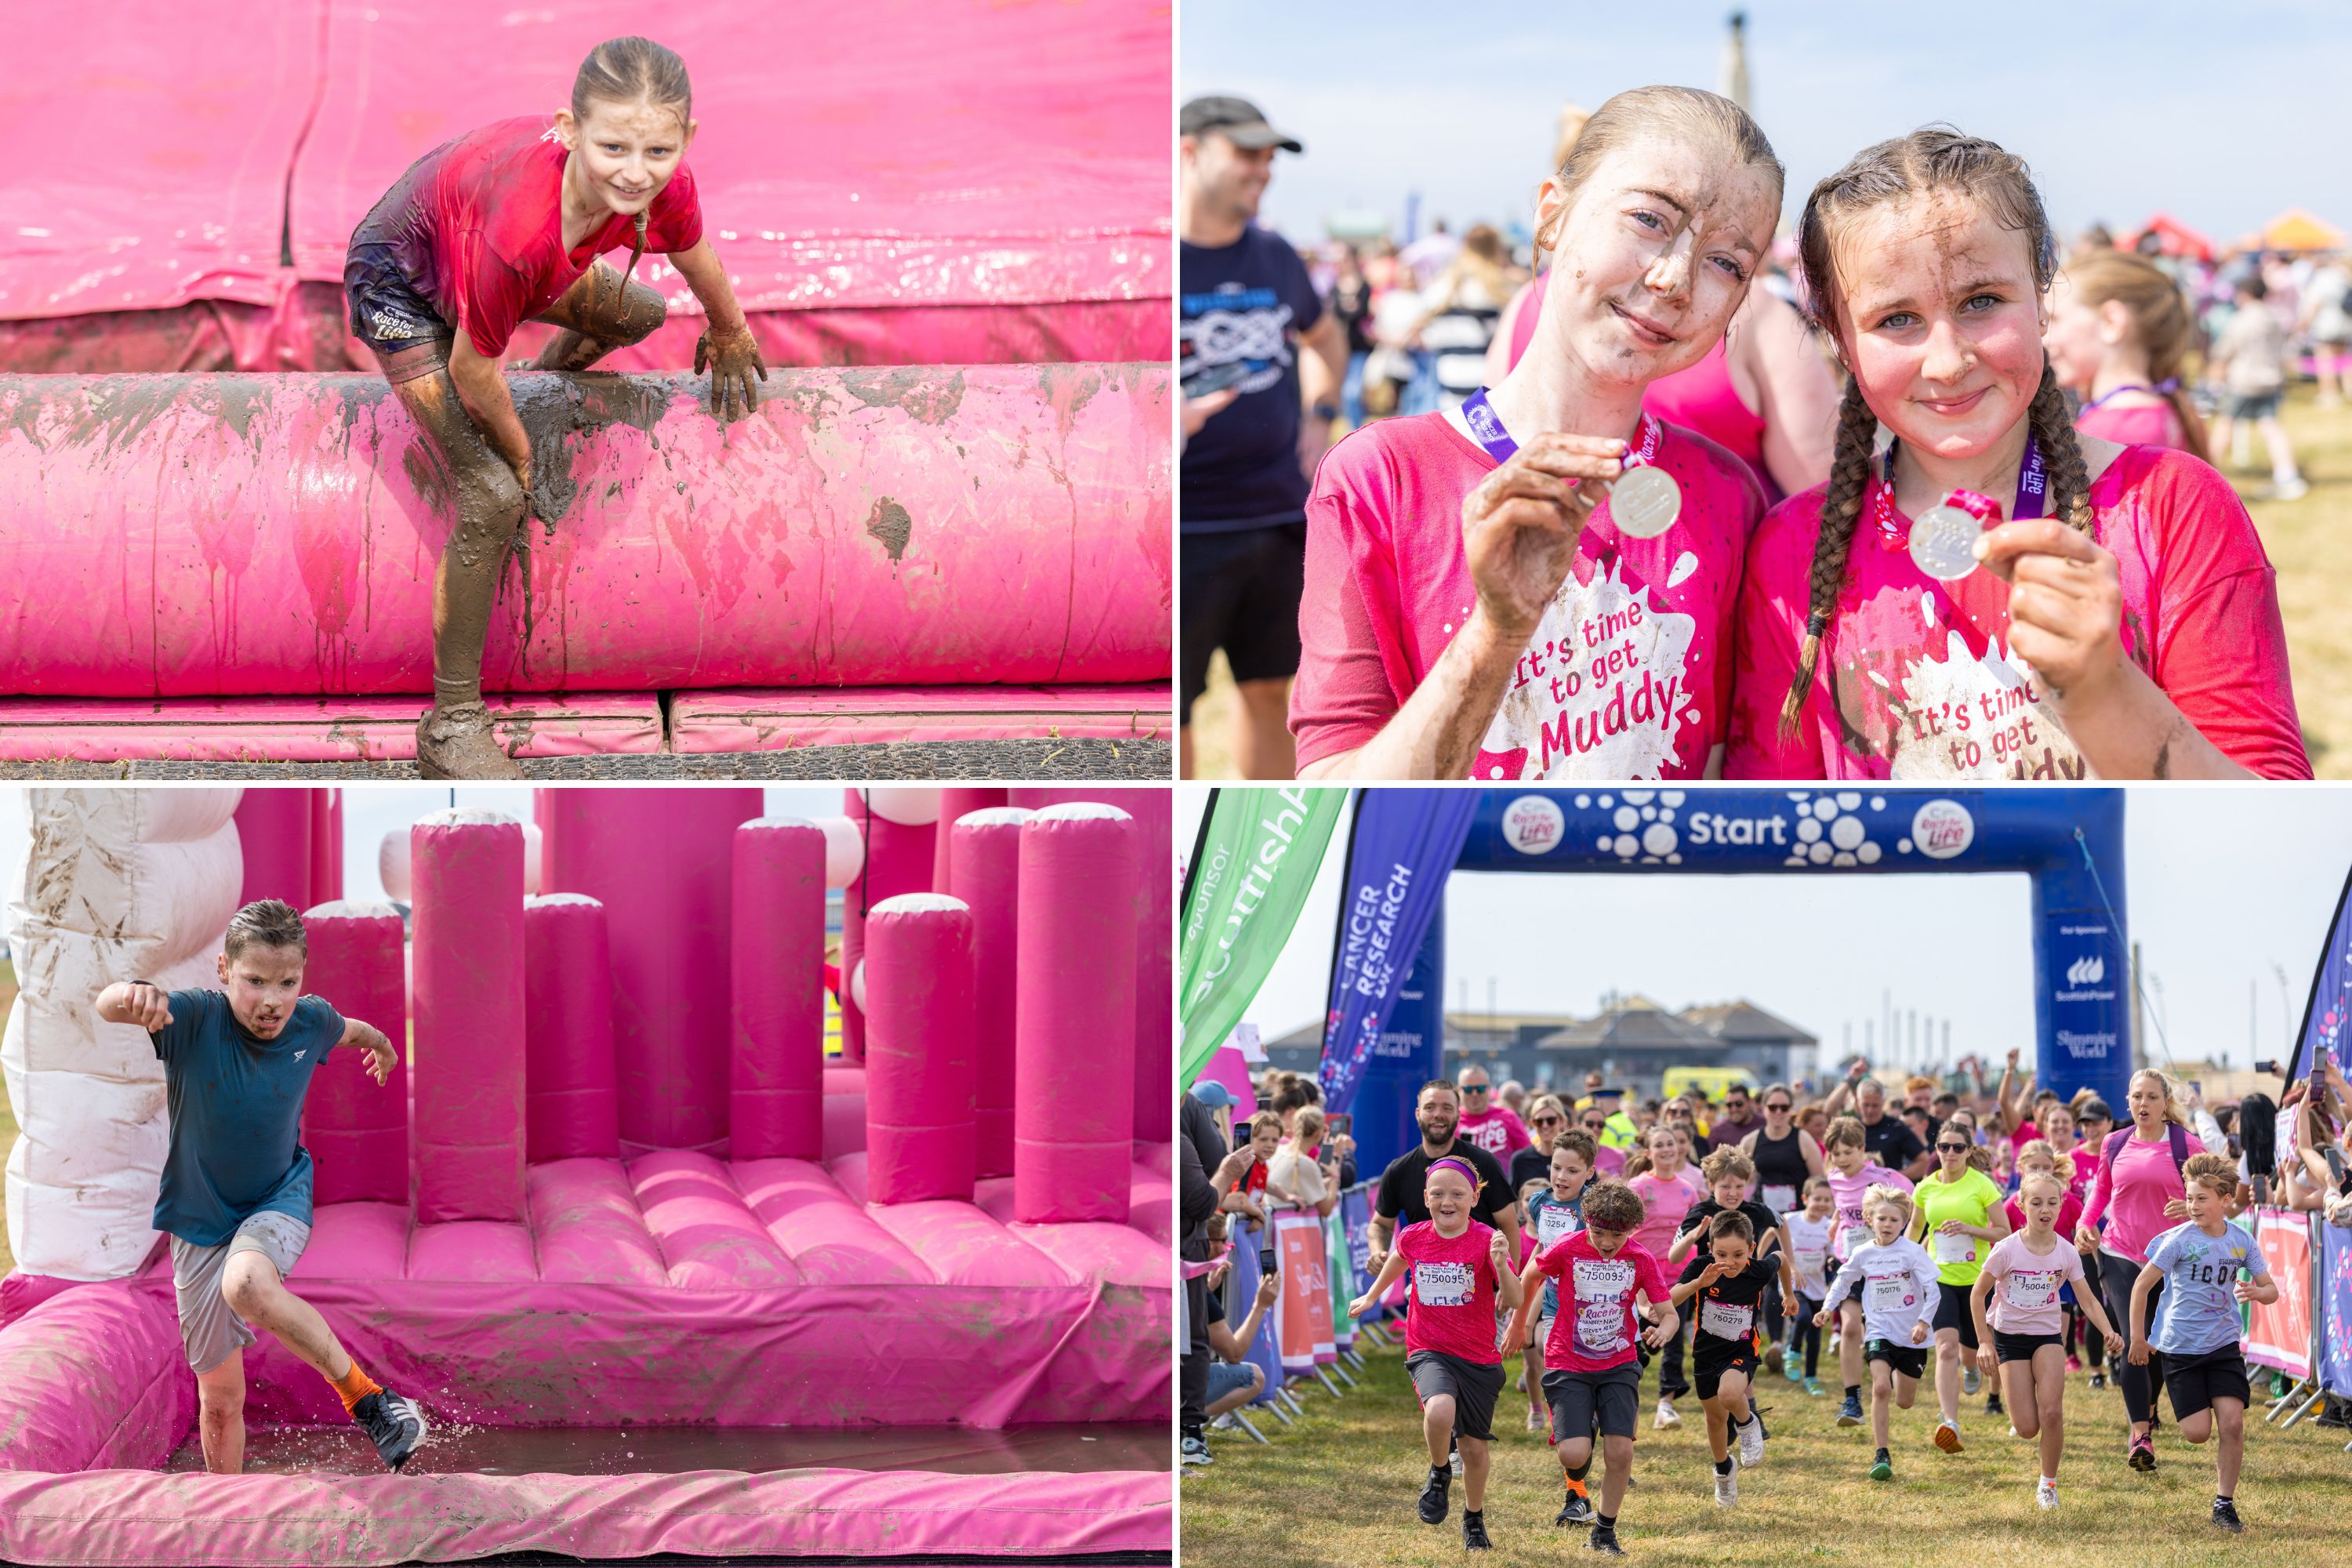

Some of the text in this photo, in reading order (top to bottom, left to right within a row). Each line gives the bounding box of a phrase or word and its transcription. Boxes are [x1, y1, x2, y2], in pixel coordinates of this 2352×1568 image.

[372, 311, 414, 329] Race for
[2026, 470, 2045, 495] Life
[1514, 601, 1642, 690] It's time
[1549, 639, 1639, 705] to get
[1541, 670, 1678, 771] Muddy
[1909, 679, 2040, 741] It's time
[1949, 716, 2038, 771] to get
[1688, 811, 1787, 846] Start
[1356, 862, 1412, 996] RESEARCH
[1424, 1274, 1465, 1283] 750095
[1584, 1271, 1624, 1281] 750093
[1875, 1286, 1900, 1294] 750176
[1585, 1308, 1619, 1319] Race for
[1713, 1313, 1743, 1324] 750279
